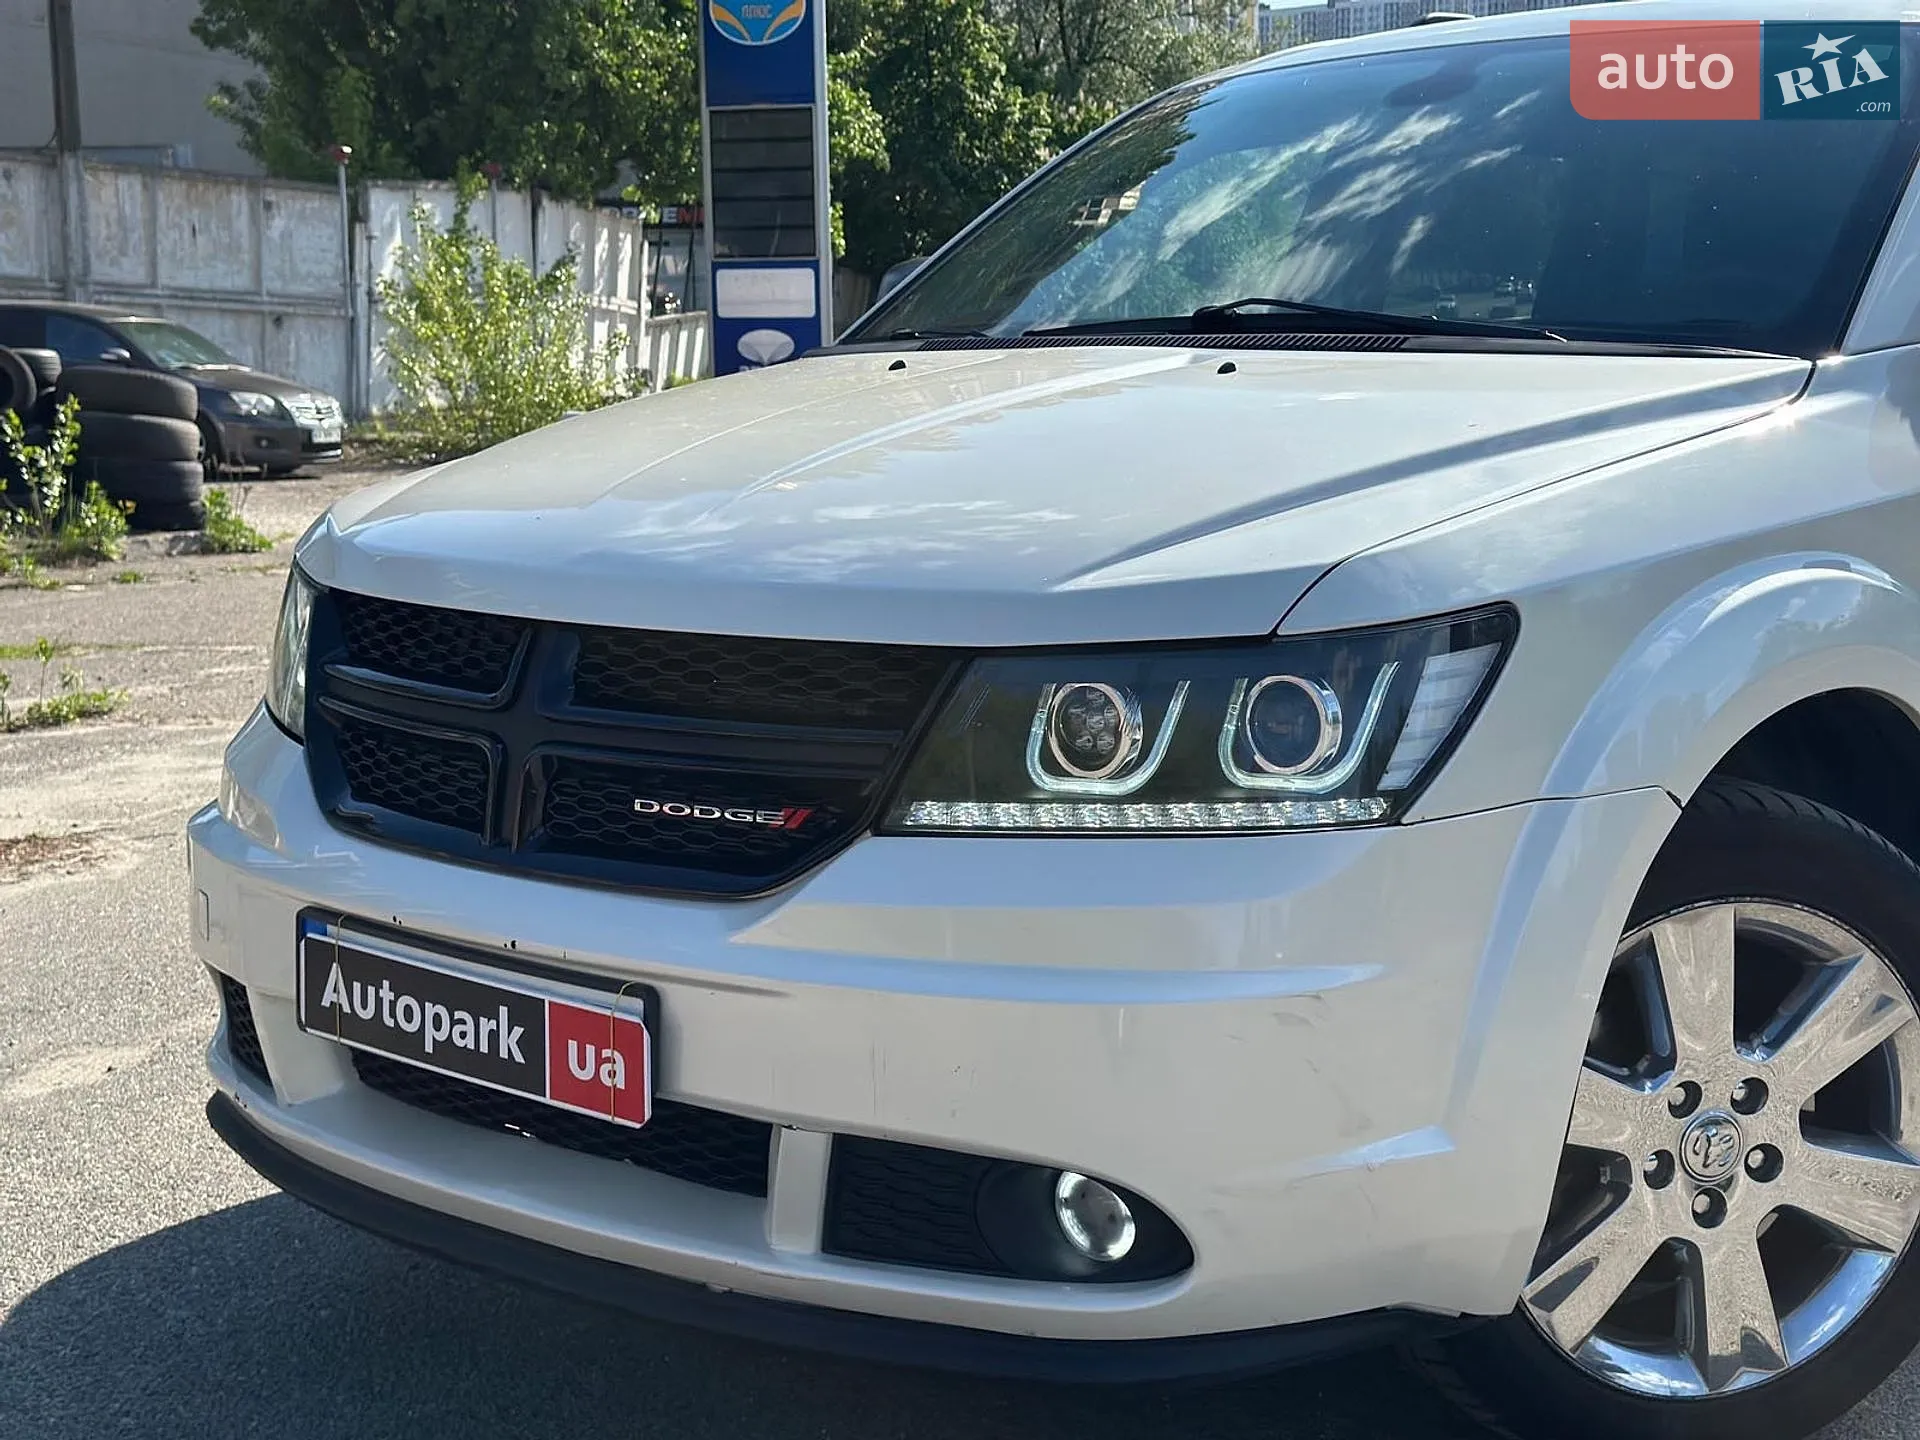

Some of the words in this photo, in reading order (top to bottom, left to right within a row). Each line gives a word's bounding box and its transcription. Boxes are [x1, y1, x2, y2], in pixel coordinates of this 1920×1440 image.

[634, 799, 785, 825] DODGE
[320, 962, 526, 1064] Autopark
[567, 1039, 626, 1090] ua
